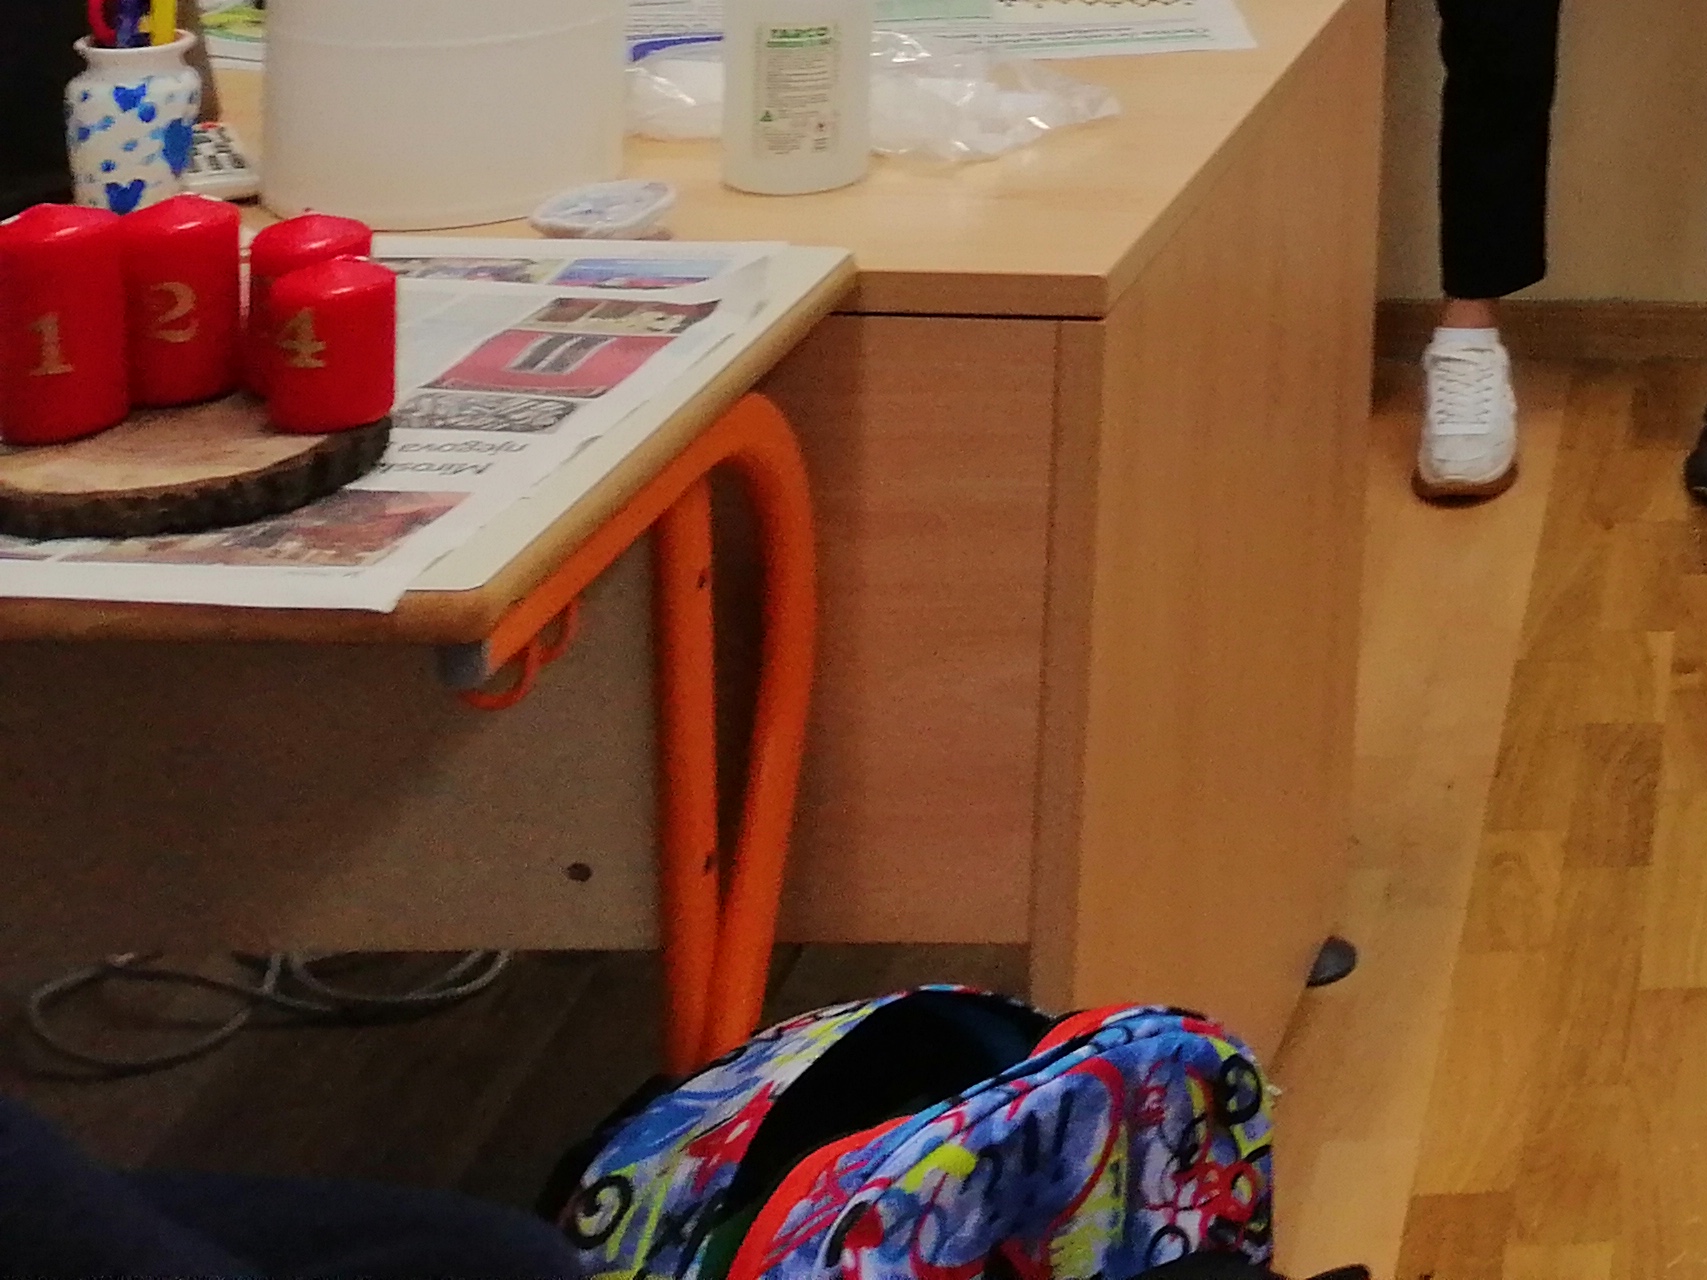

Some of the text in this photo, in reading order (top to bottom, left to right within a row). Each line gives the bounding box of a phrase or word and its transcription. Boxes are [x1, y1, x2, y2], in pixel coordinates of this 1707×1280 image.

[151, 281, 197, 343] 2
[277, 307, 327, 369] 4
[24, 312, 75, 376] 1
